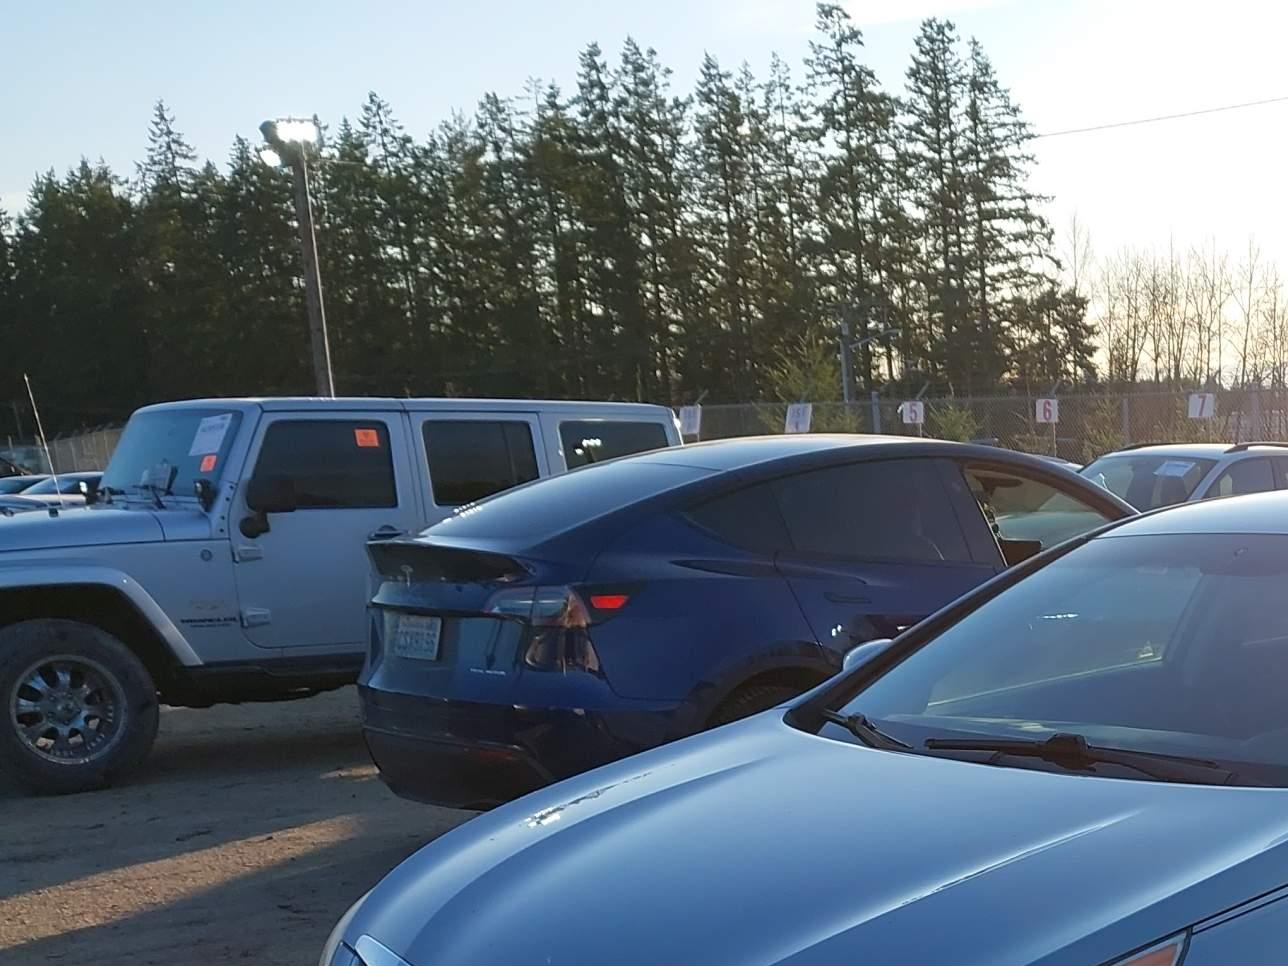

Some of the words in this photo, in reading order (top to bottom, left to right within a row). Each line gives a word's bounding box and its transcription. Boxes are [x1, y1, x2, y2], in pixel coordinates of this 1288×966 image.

[910, 402, 917, 421] 5
[1043, 399, 1051, 420] 6
[1198, 394, 1207, 416] 7
